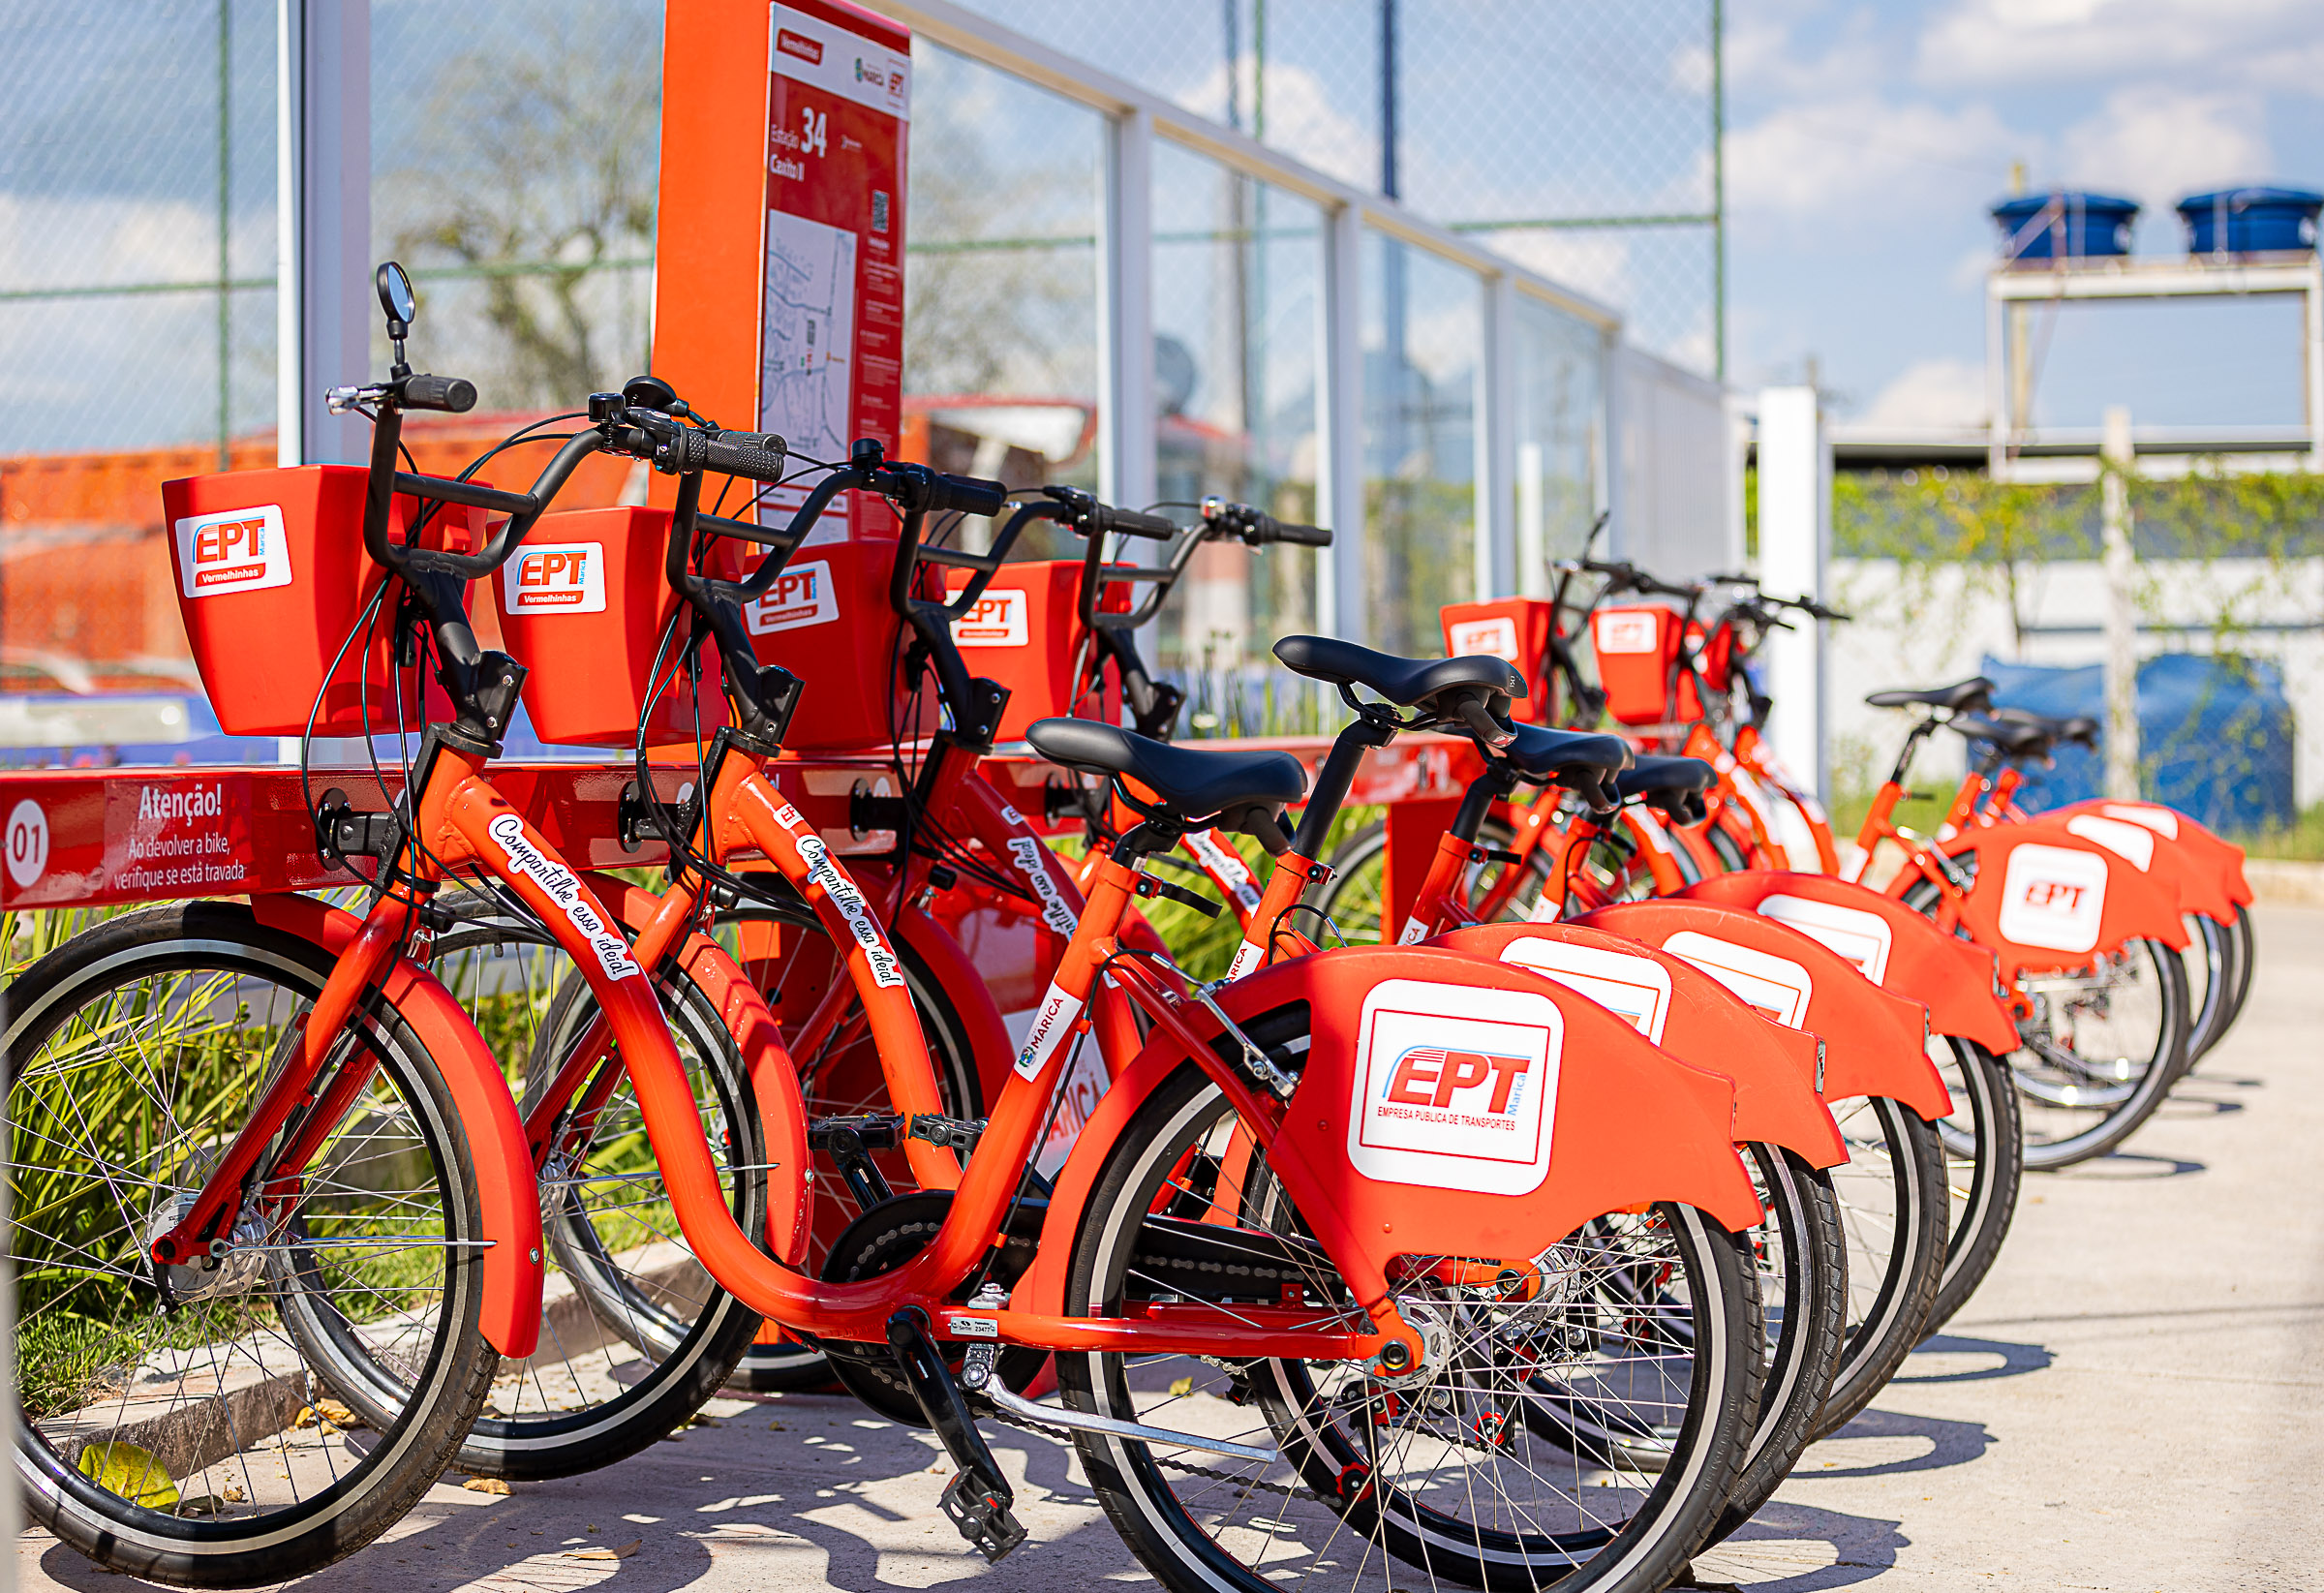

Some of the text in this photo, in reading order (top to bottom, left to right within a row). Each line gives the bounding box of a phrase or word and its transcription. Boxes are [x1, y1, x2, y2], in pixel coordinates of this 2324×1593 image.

[801, 107, 828, 158] 34
[197, 518, 265, 565] EPT
[201, 568, 260, 583] Vermelhinhas
[520, 552, 587, 586] EPT
[524, 595, 577, 603] Vermelhinhas
[138, 783, 223, 827] Atenção!
[13, 821, 41, 865] 01
[129, 831, 230, 860] Ao devolver a bike,
[114, 859, 245, 893] verifique se está travada
[495, 819, 634, 975] Compartilhe essa ideia!
[2024, 882, 2087, 912] EPT
[802, 839, 901, 983] Compartilhe essa ideia!
[1388, 1050, 1531, 1115] EPT
[1507, 1074, 1526, 1117] Maricá
[1377, 1106, 1515, 1131] EMPRESA PÚBLICA DE TRANSPORTES
